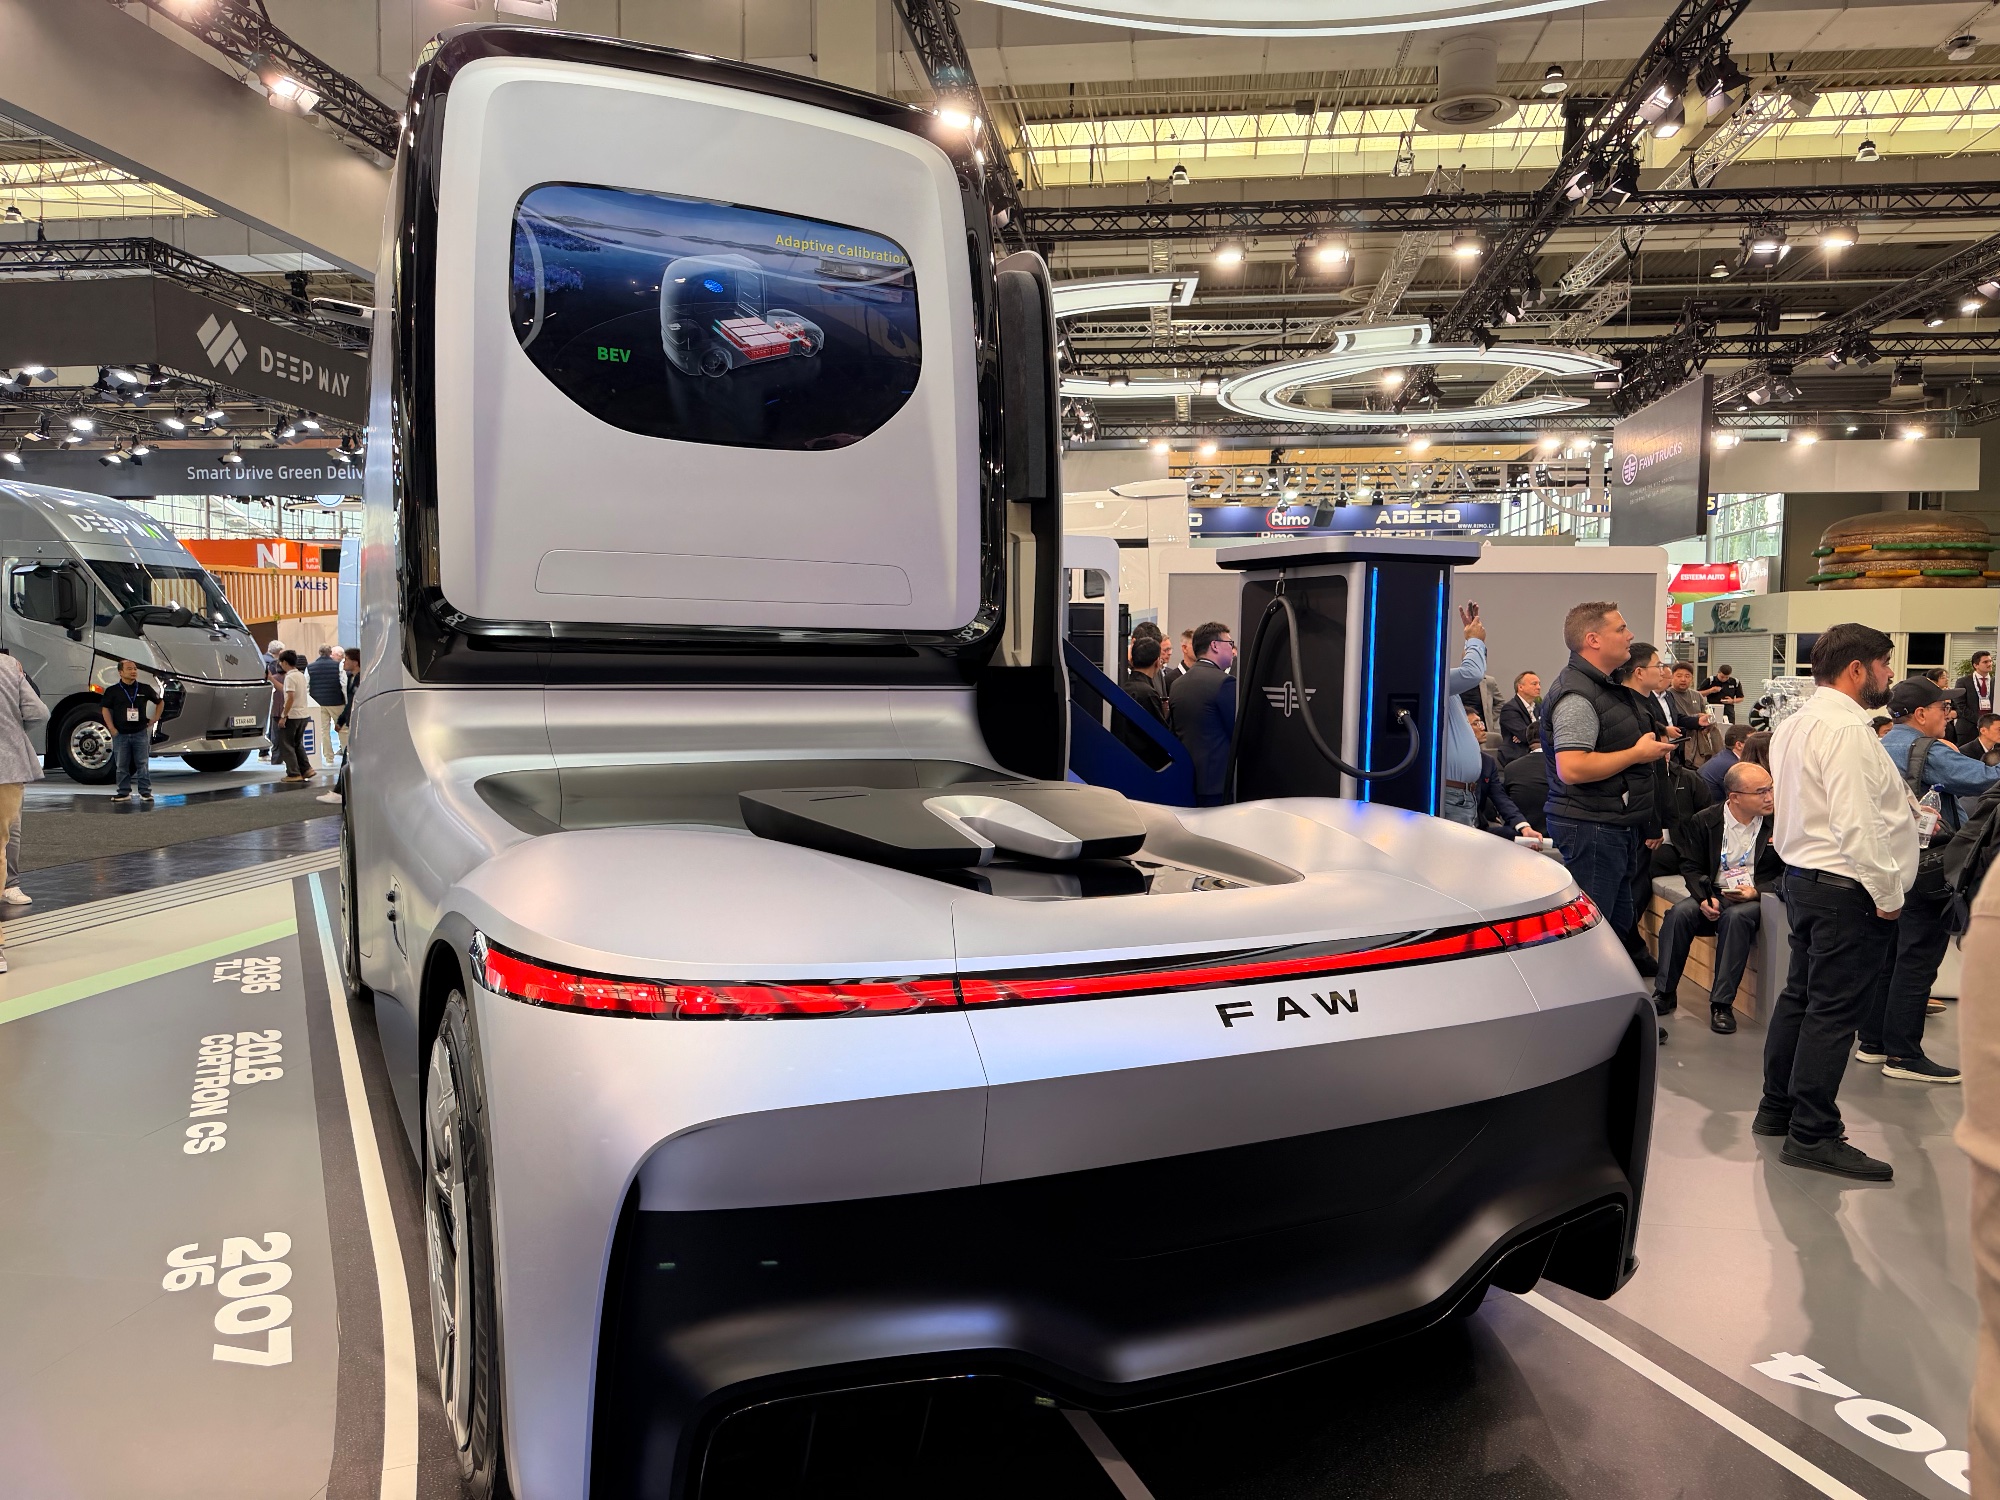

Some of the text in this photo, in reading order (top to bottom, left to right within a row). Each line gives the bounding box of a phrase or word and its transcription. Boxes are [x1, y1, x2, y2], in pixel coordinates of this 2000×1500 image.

[775, 234, 909, 264] Adaptive Calibration
[597, 346, 631, 363] BEV
[1655, 441, 1683, 463] TRUCKS
[187, 466, 231, 480] Smart
[235, 465, 274, 480] Drive
[278, 465, 322, 480] Green
[1271, 510, 1461, 526] Rimo ADERO
[256, 543, 298, 570] NL
[294, 581, 328, 591] AXLES
[1680, 573, 1726, 581] ESTEEM AUTO
[212, 958, 242, 984] TLX
[240, 956, 282, 993] 2036
[1214, 988, 1359, 1028] FAW
[232, 1030, 284, 1085] 2018
[183, 1033, 234, 1155] CORTRON CS
[161, 1243, 217, 1292] J6
[212, 1232, 293, 1367] 2007
